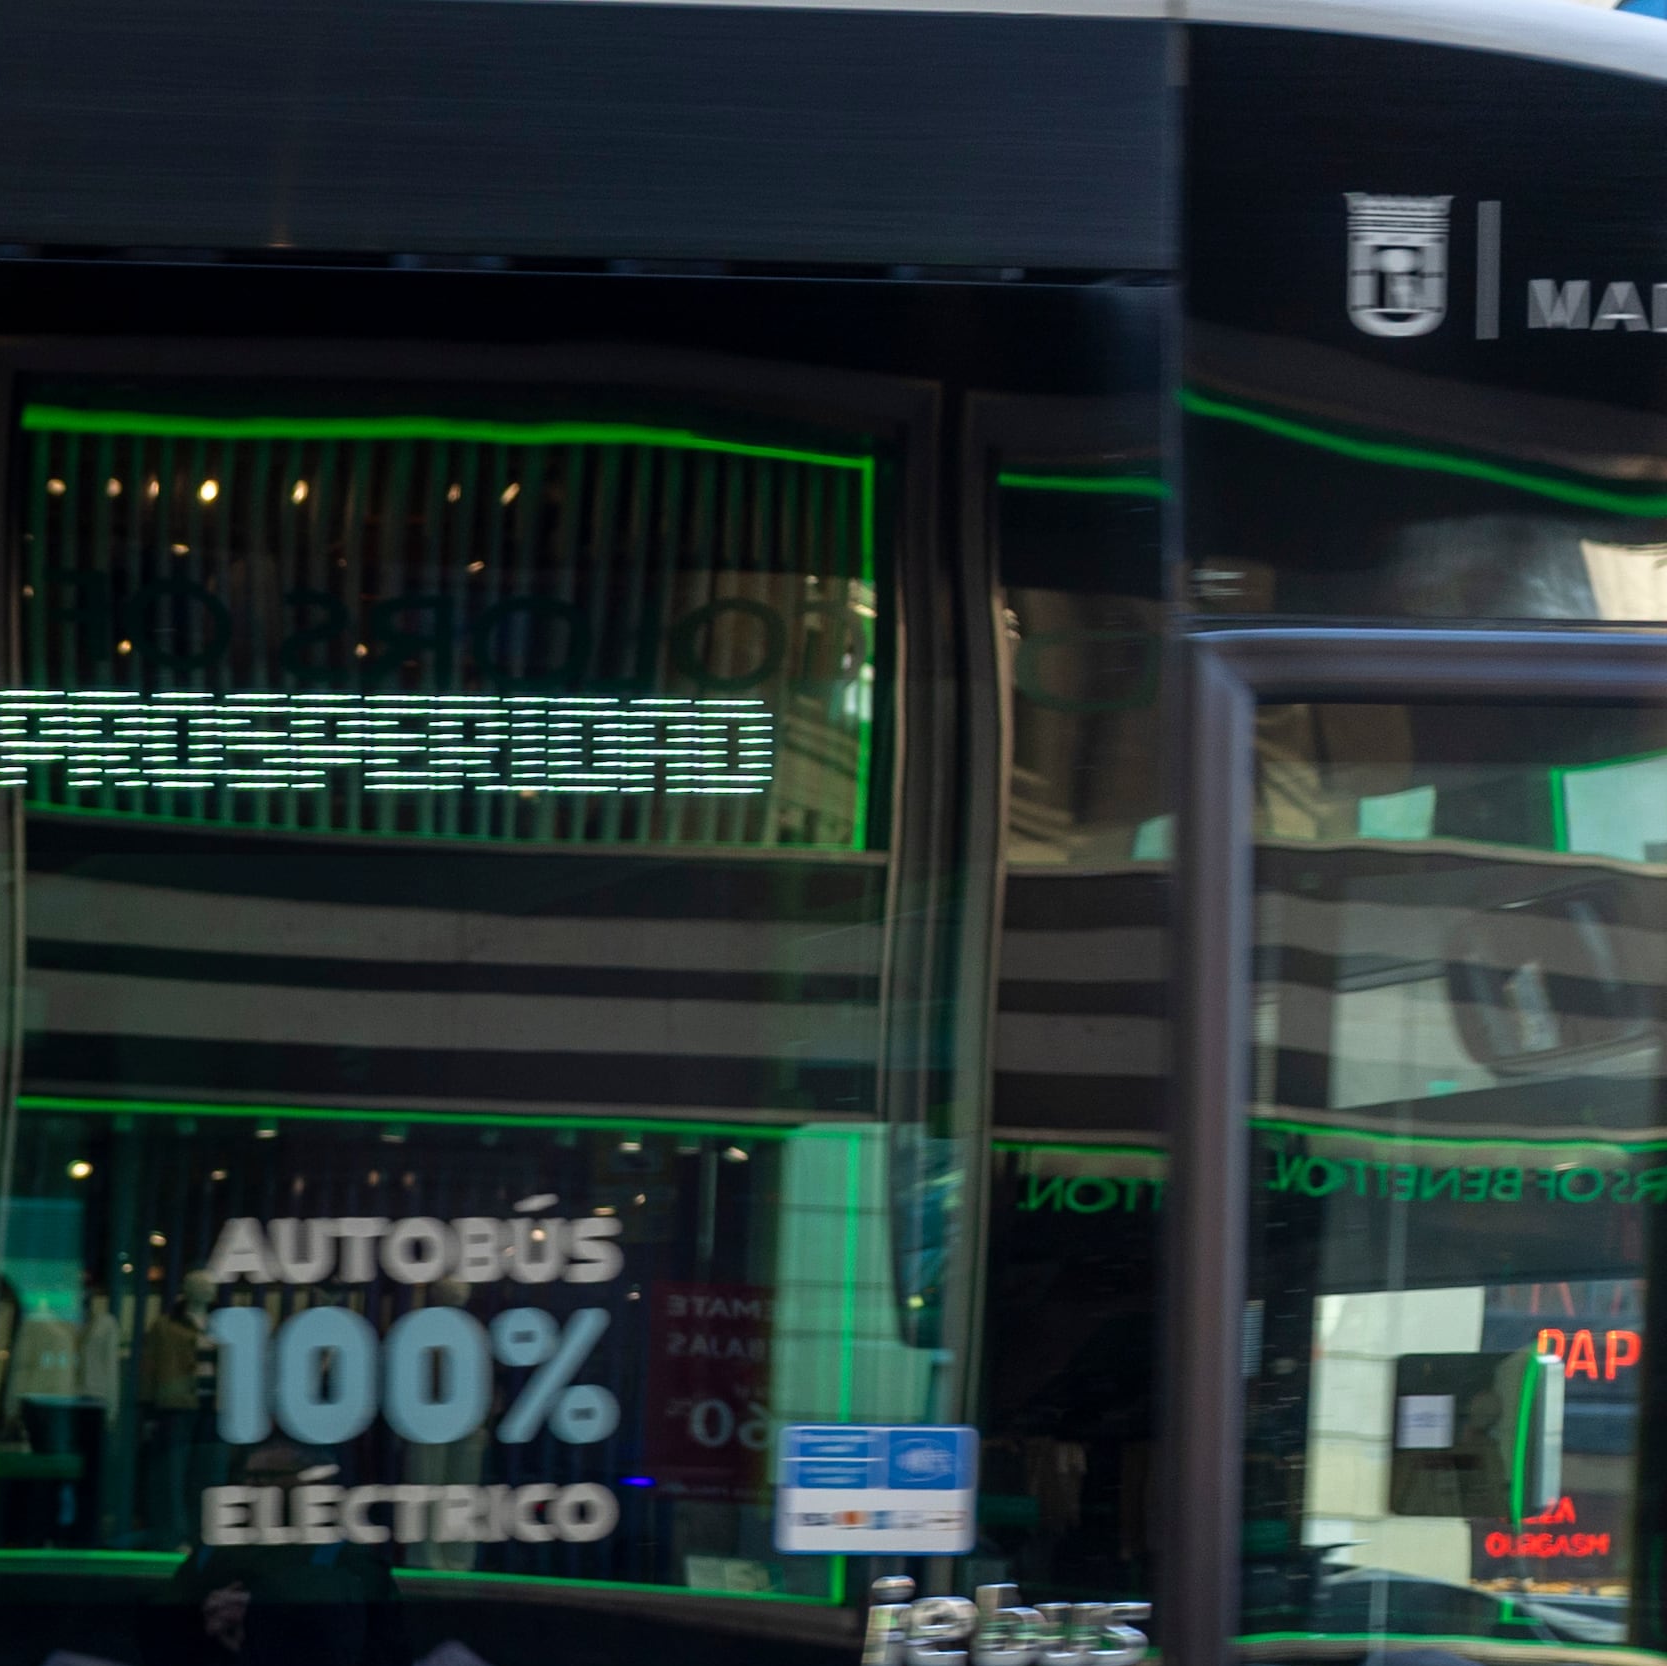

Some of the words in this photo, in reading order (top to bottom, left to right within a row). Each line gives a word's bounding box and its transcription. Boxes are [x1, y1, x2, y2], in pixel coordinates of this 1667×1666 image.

[209, 1193, 624, 1283] AUTOBÚS
[208, 1306, 622, 1445] 100%
[201, 1463, 621, 1546] ELÉCTRICO
